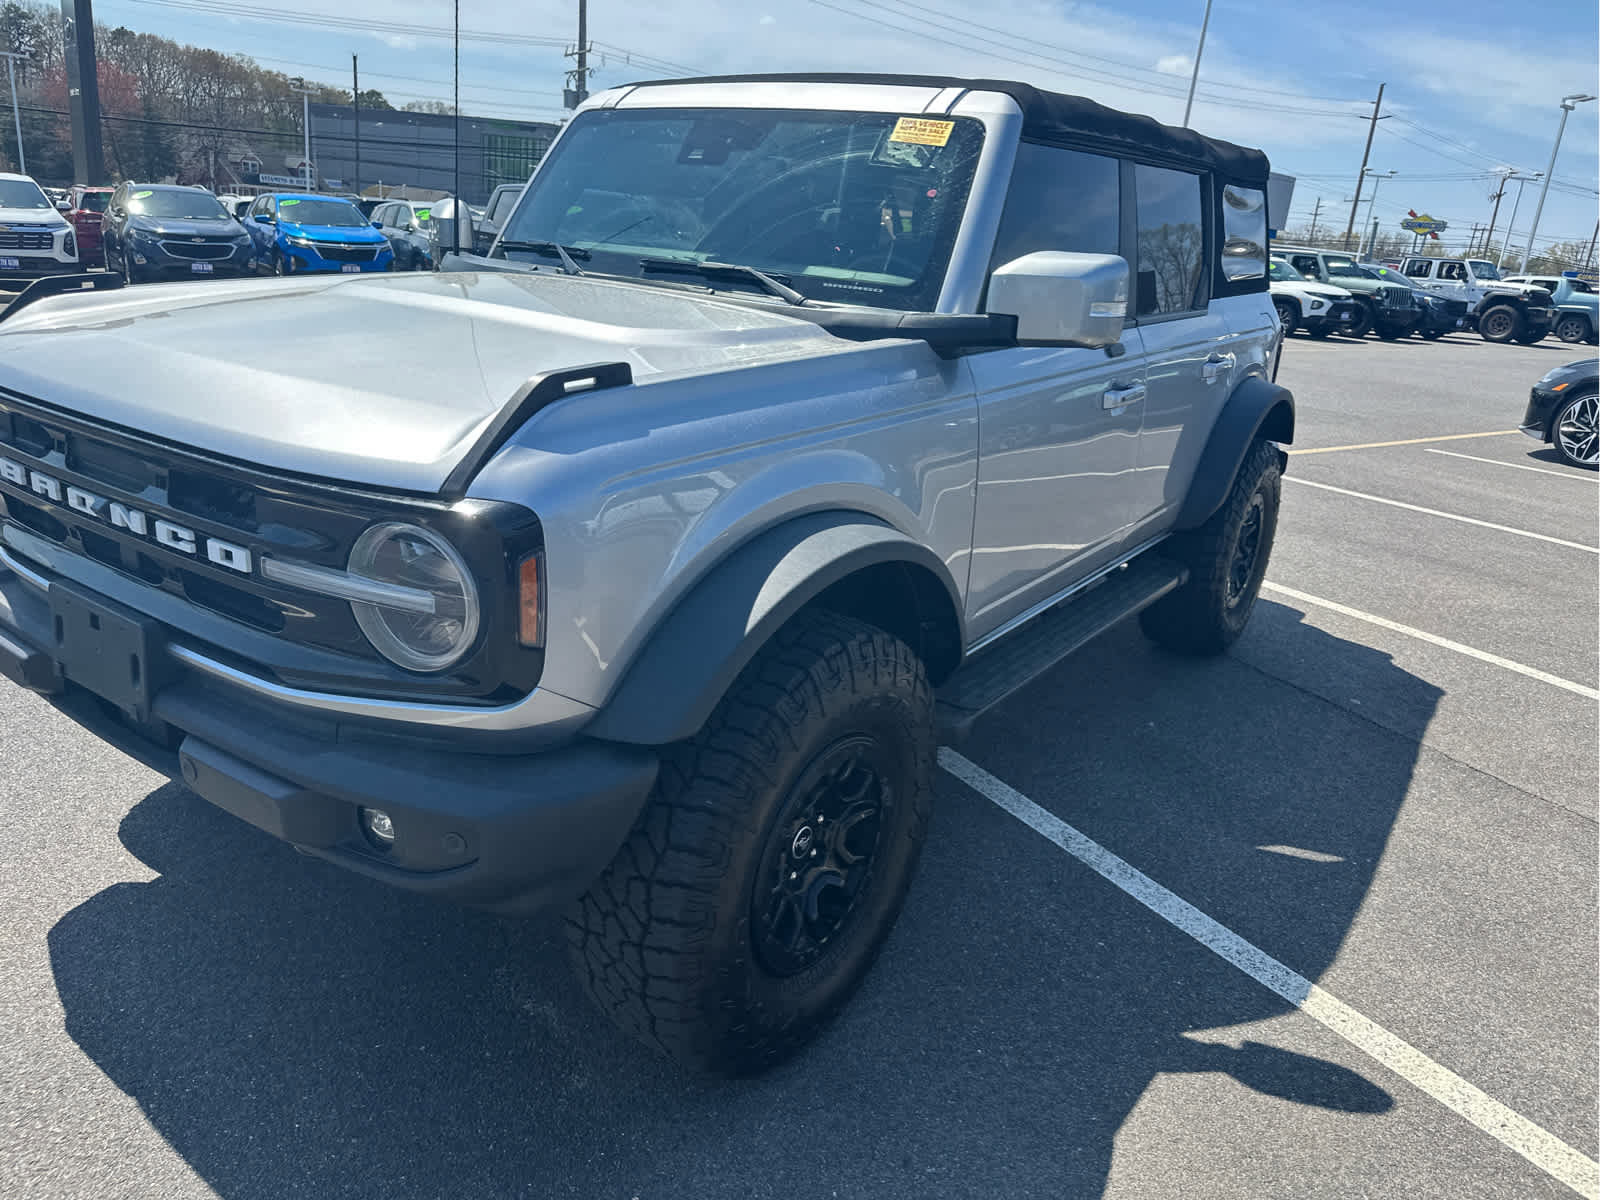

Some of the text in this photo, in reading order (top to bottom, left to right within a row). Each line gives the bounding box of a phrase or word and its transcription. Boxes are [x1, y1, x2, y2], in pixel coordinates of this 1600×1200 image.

[901, 119, 952, 130] THIS VEHICLE
[0, 456, 252, 573] BRONCO
